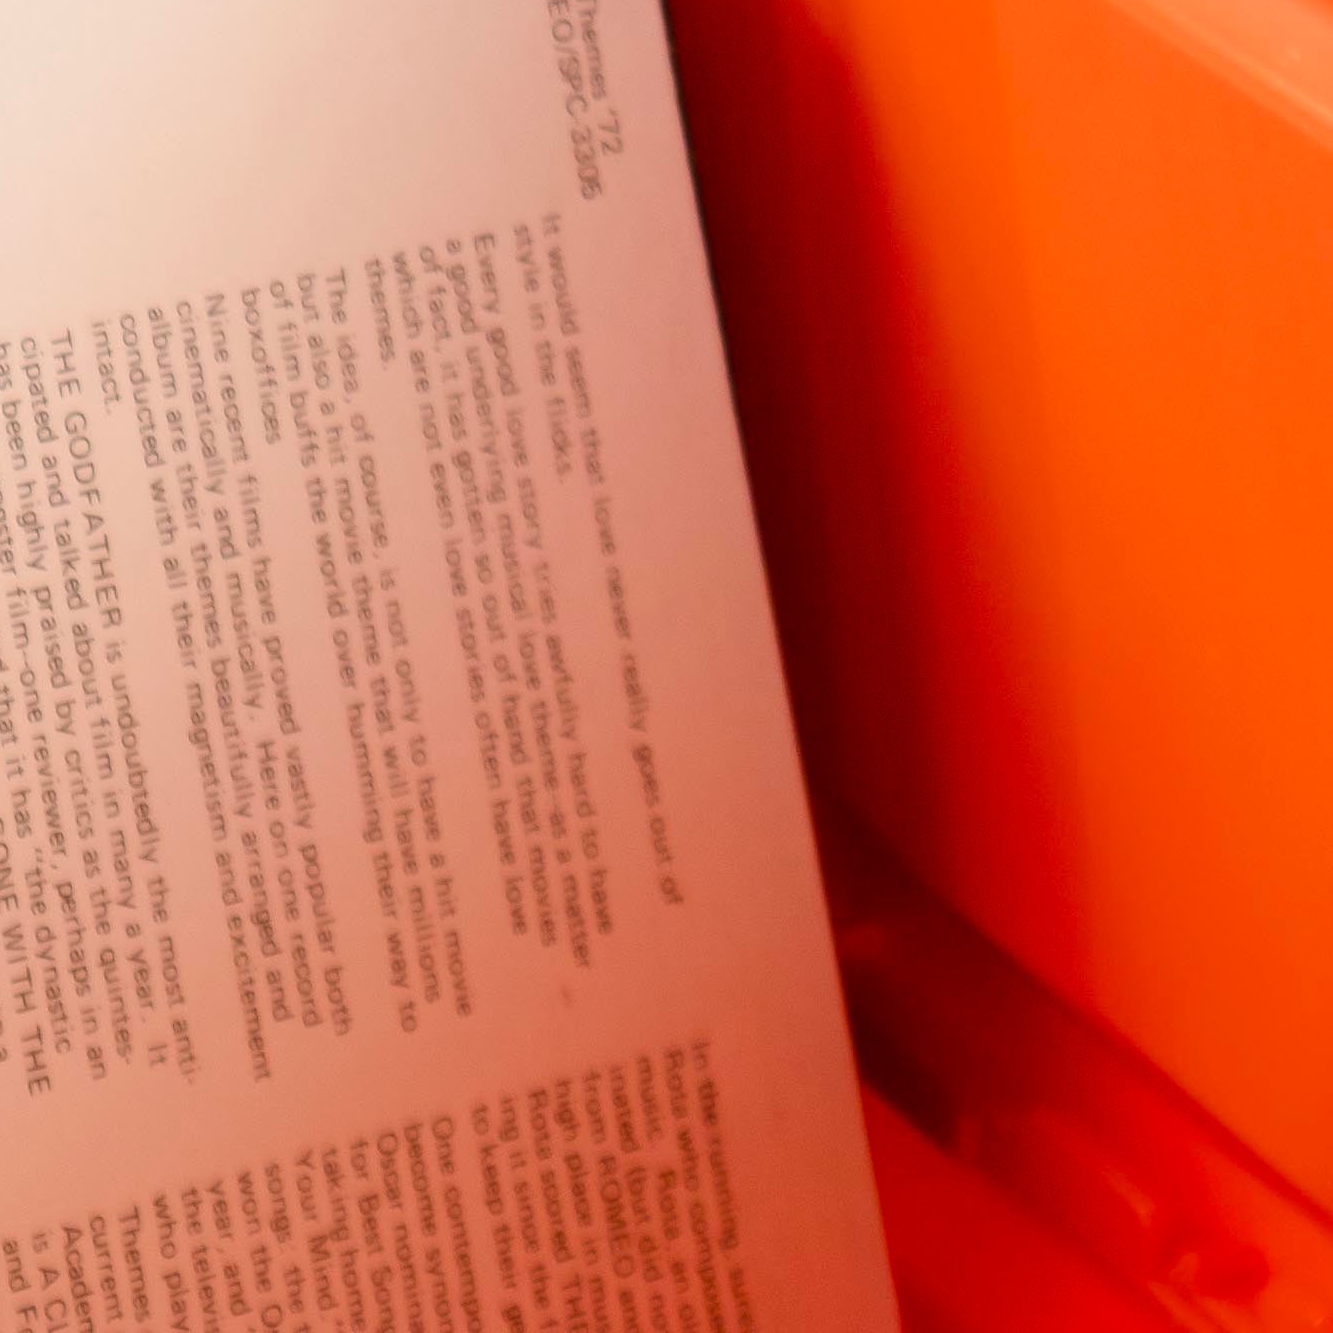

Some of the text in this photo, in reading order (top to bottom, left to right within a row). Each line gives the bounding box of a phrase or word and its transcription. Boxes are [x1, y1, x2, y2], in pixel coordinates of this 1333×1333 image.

[0, 398, 27, 471] been
[15, 478, 48, 571] highly
[541, 211, 684, 905] It would seem that love never really goes out of
[5, 585, 44, 723] film--one
[29, 584, 72, 689] praised
[204, 292, 353, 1036] Nine recent films have proved vastly popular both
[324, 266, 472, 1017] The idea, of course, is not only to have a hit movie
[19, 336, 168, 1067] cipated and talked about film in many a year. It
[50, 328, 197, 1085] THE GODFATHER is undoubtedly the most anti-
[54, 697, 76, 736] by
[4, 755, 26, 779] it
[10, 786, 32, 839] has
[31, 732, 67, 869] reviewer,
[63, 747, 95, 840] critics
[81, 847, 101, 879] as
[88, 885, 113, 935] the
[33, 923, 71, 1054] dynastic
[51, 880, 91, 997] perhaps
[1, 922, 37, 1014] WITH
[20, 1023, 51, 1095] THE
[79, 1005, 101, 1036] in
[85, 1044, 106, 1080] an
[96, 945, 132, 1065] quintes-
[294, 1147, 318, 1221] Your
[348, 1135, 384, 1256] for Best
[375, 1128, 404, 1211] Oscar
[401, 1121, 438, 1238] become
[430, 1113, 457, 1176] One
[469, 1101, 518, 1289] to keep their
[30, 1229, 61, 1291] is A
[117, 1204, 151, 1324] Themes
[151, 1193, 177, 1260] who
[180, 1185, 203, 1235] the
[203, 1177, 253, 1317] year, and
[235, 1169, 273, 1293] won the
[320, 1145, 366, 1333] taking home
[87, 1212, 124, 1324] current
